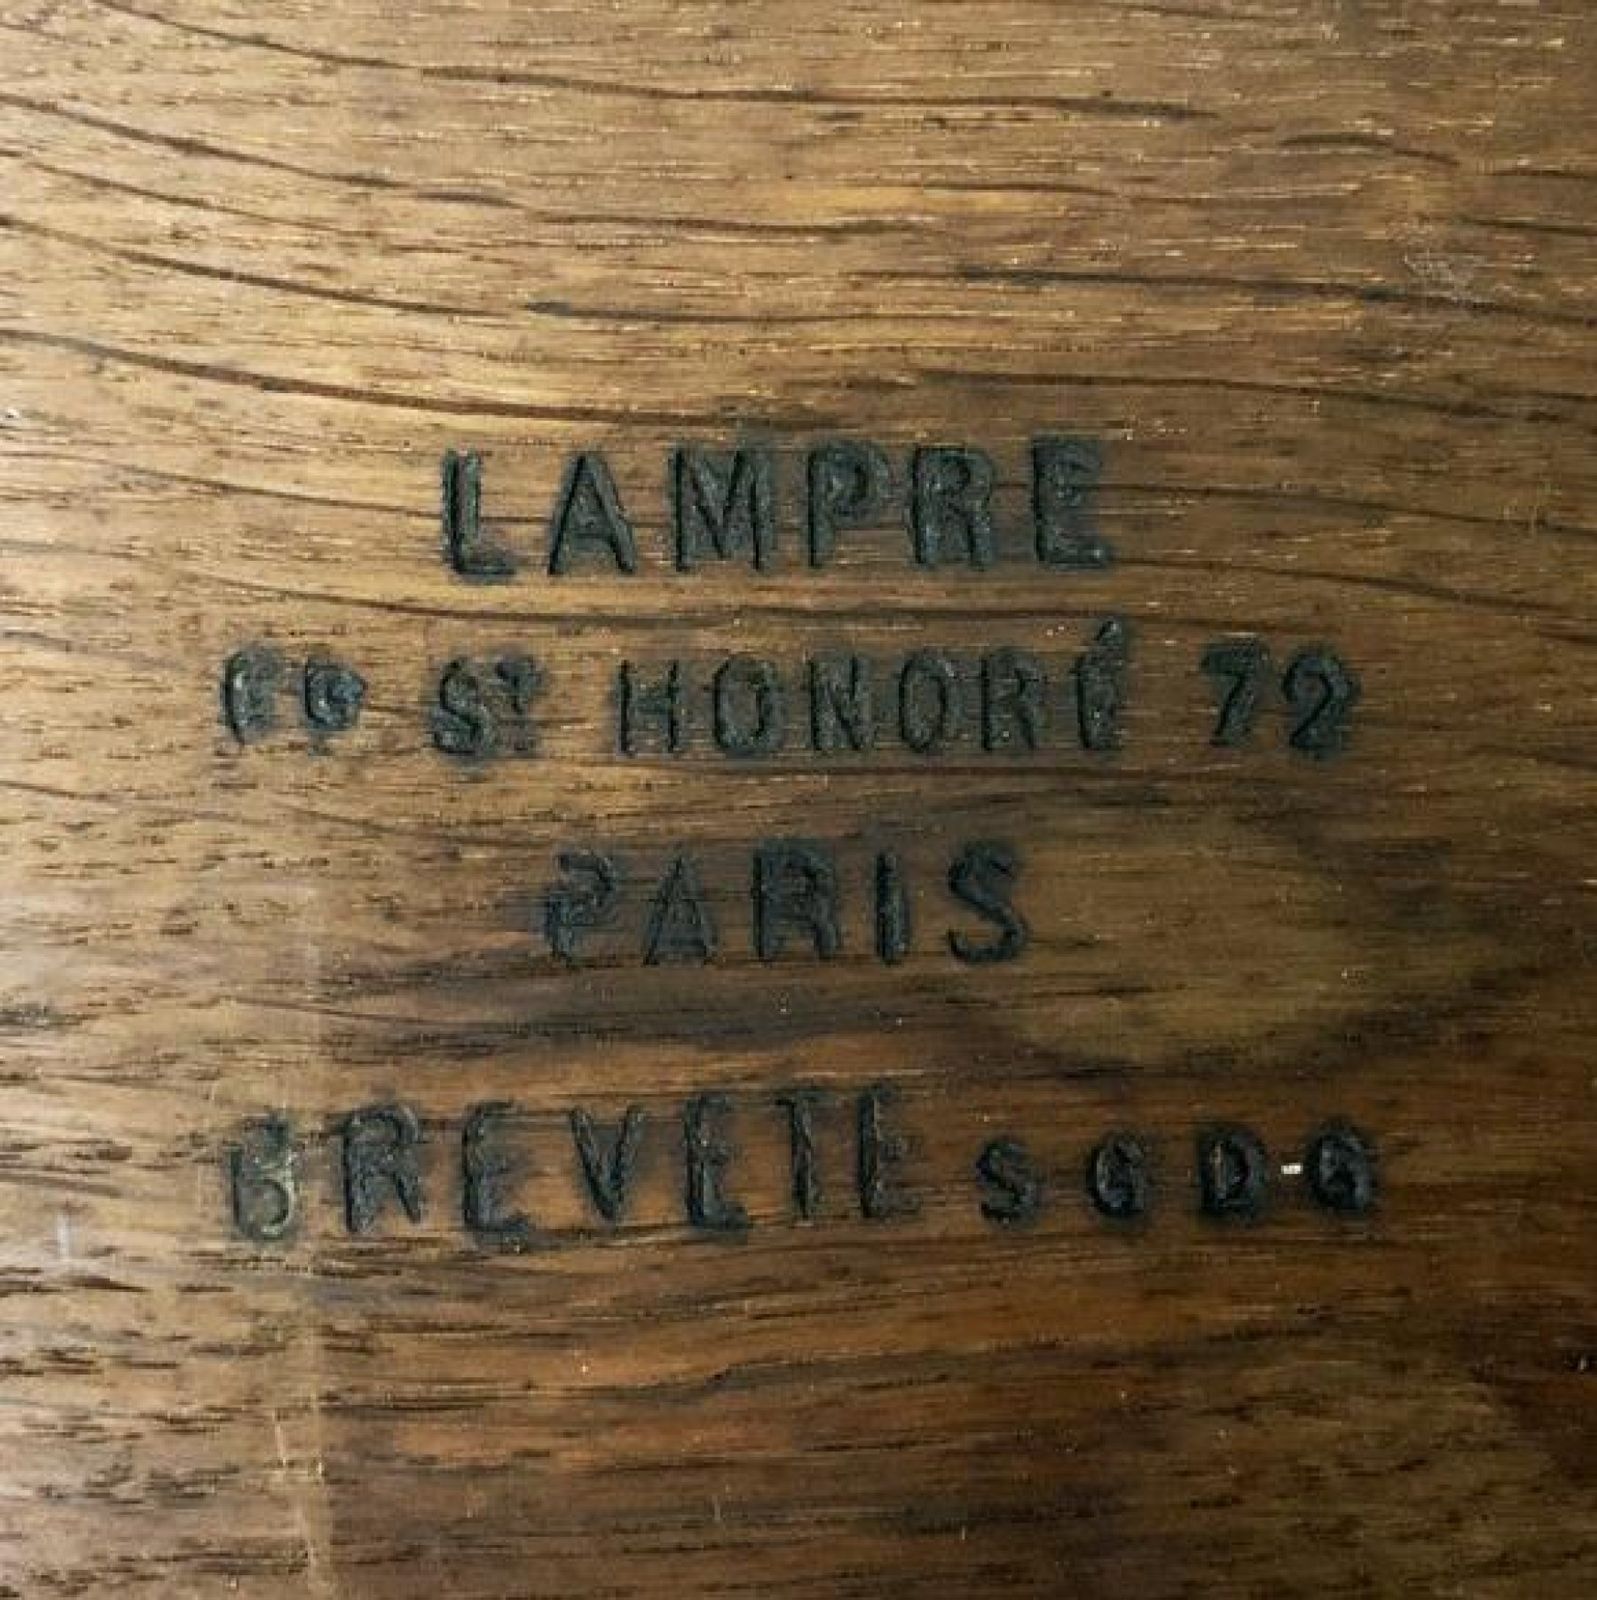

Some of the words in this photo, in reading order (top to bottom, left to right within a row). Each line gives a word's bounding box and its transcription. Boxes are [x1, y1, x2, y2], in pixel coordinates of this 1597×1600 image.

[441, 438, 1112, 583] LAMPRE
[618, 619, 1132, 755] HONORÉ
[1201, 641, 1361, 760] 72
[545, 840, 1028, 966] PARIS
